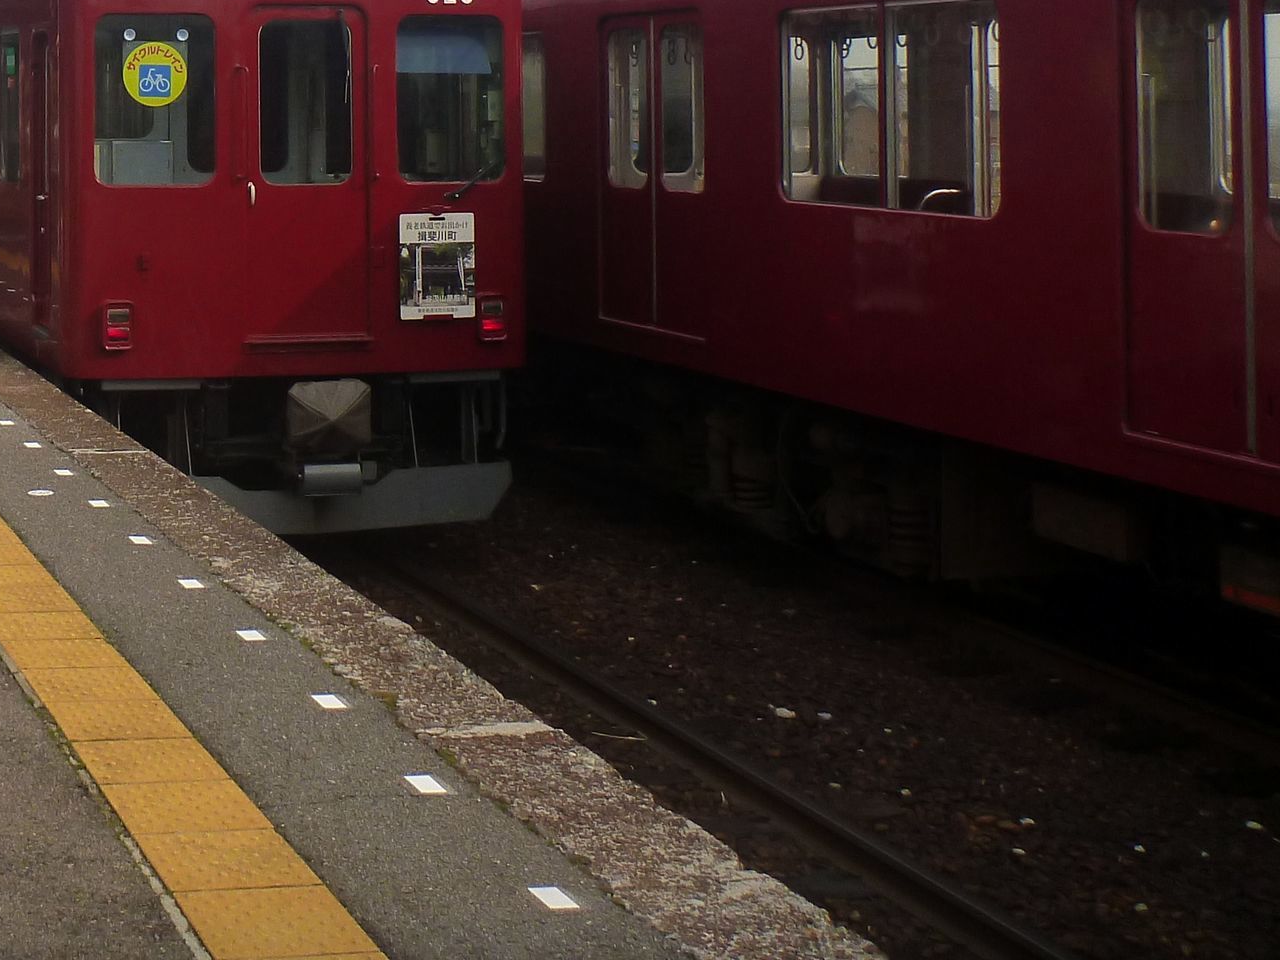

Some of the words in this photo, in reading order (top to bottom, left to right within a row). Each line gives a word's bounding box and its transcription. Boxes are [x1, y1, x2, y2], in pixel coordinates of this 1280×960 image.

[127, 46, 183, 74] サイクルトレイン
